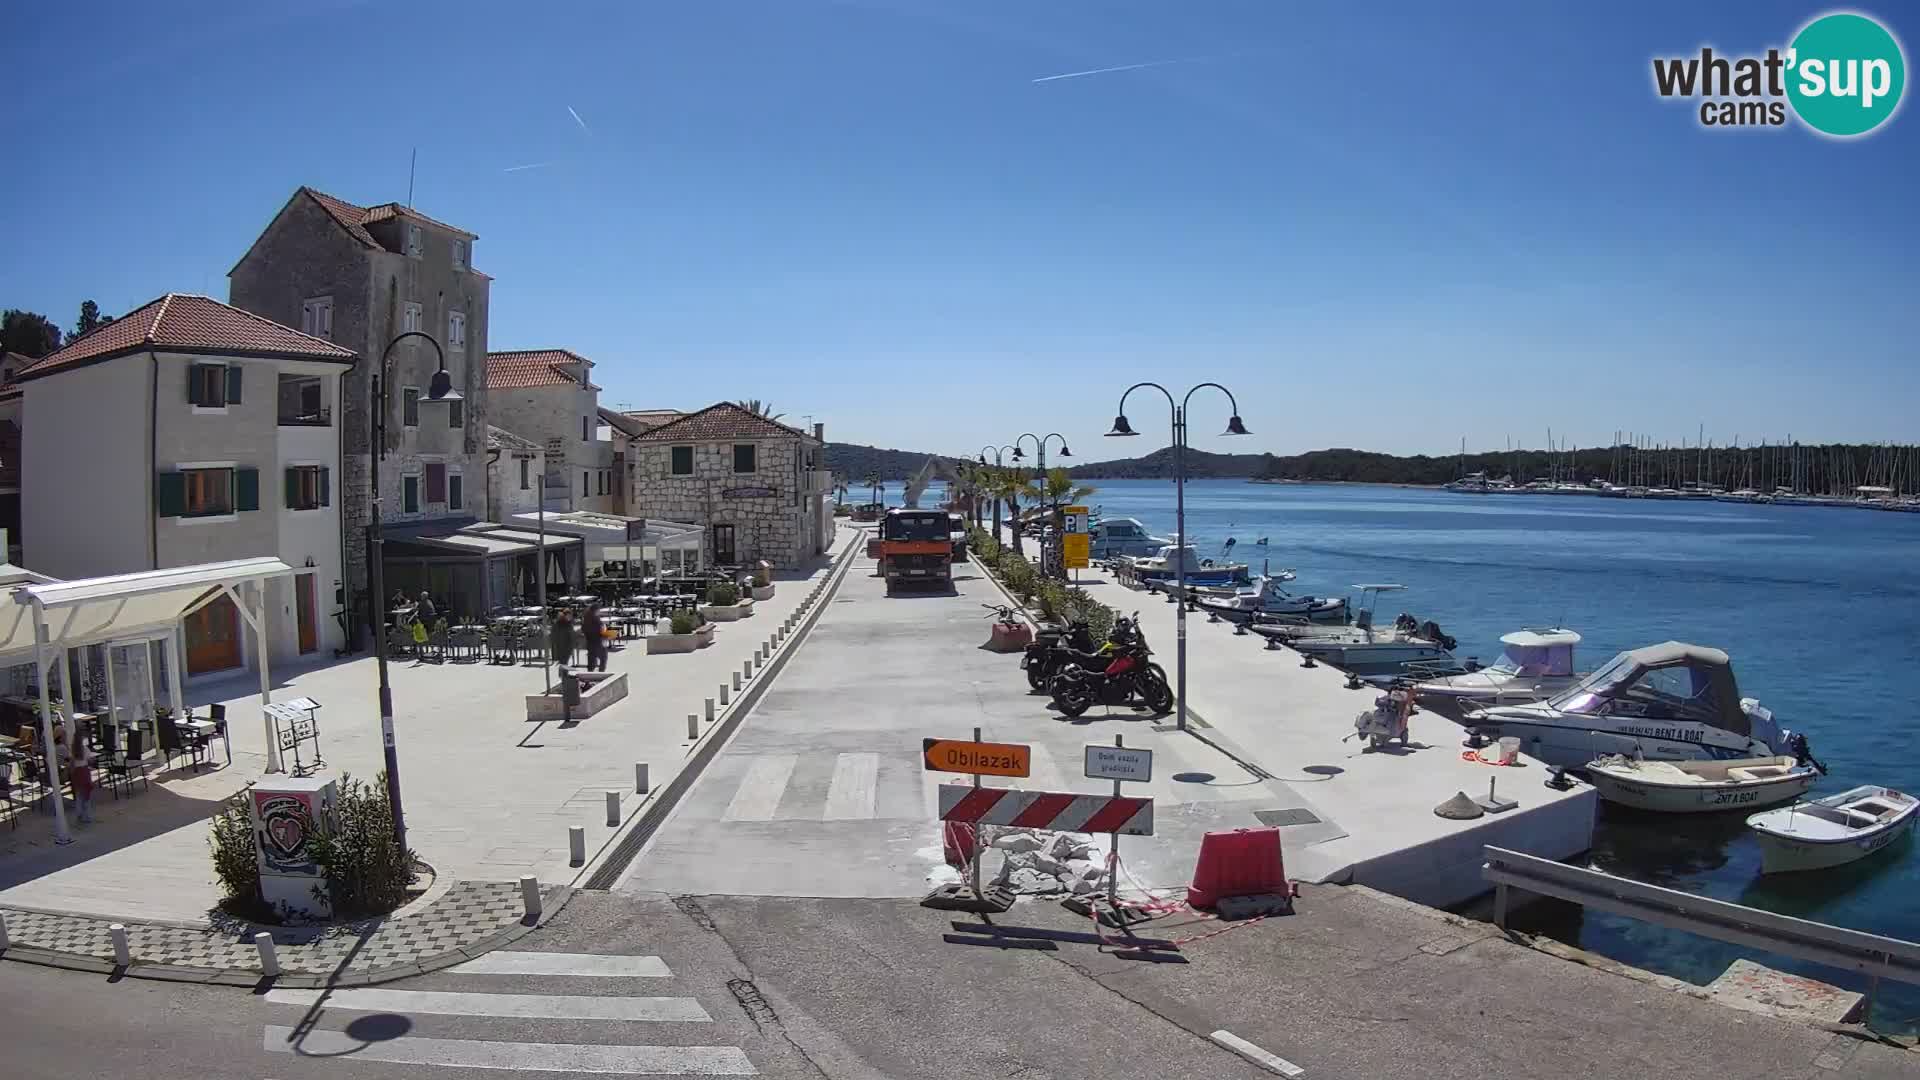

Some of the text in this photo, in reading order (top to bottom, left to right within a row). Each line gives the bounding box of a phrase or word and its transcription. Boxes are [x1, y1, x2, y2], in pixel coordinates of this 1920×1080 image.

[1676, 729, 1683, 741] A
[1684, 730, 1705, 743] BOAT
[947, 748, 1022, 770] Obilazak
[1739, 791, 1759, 802] BOAT
